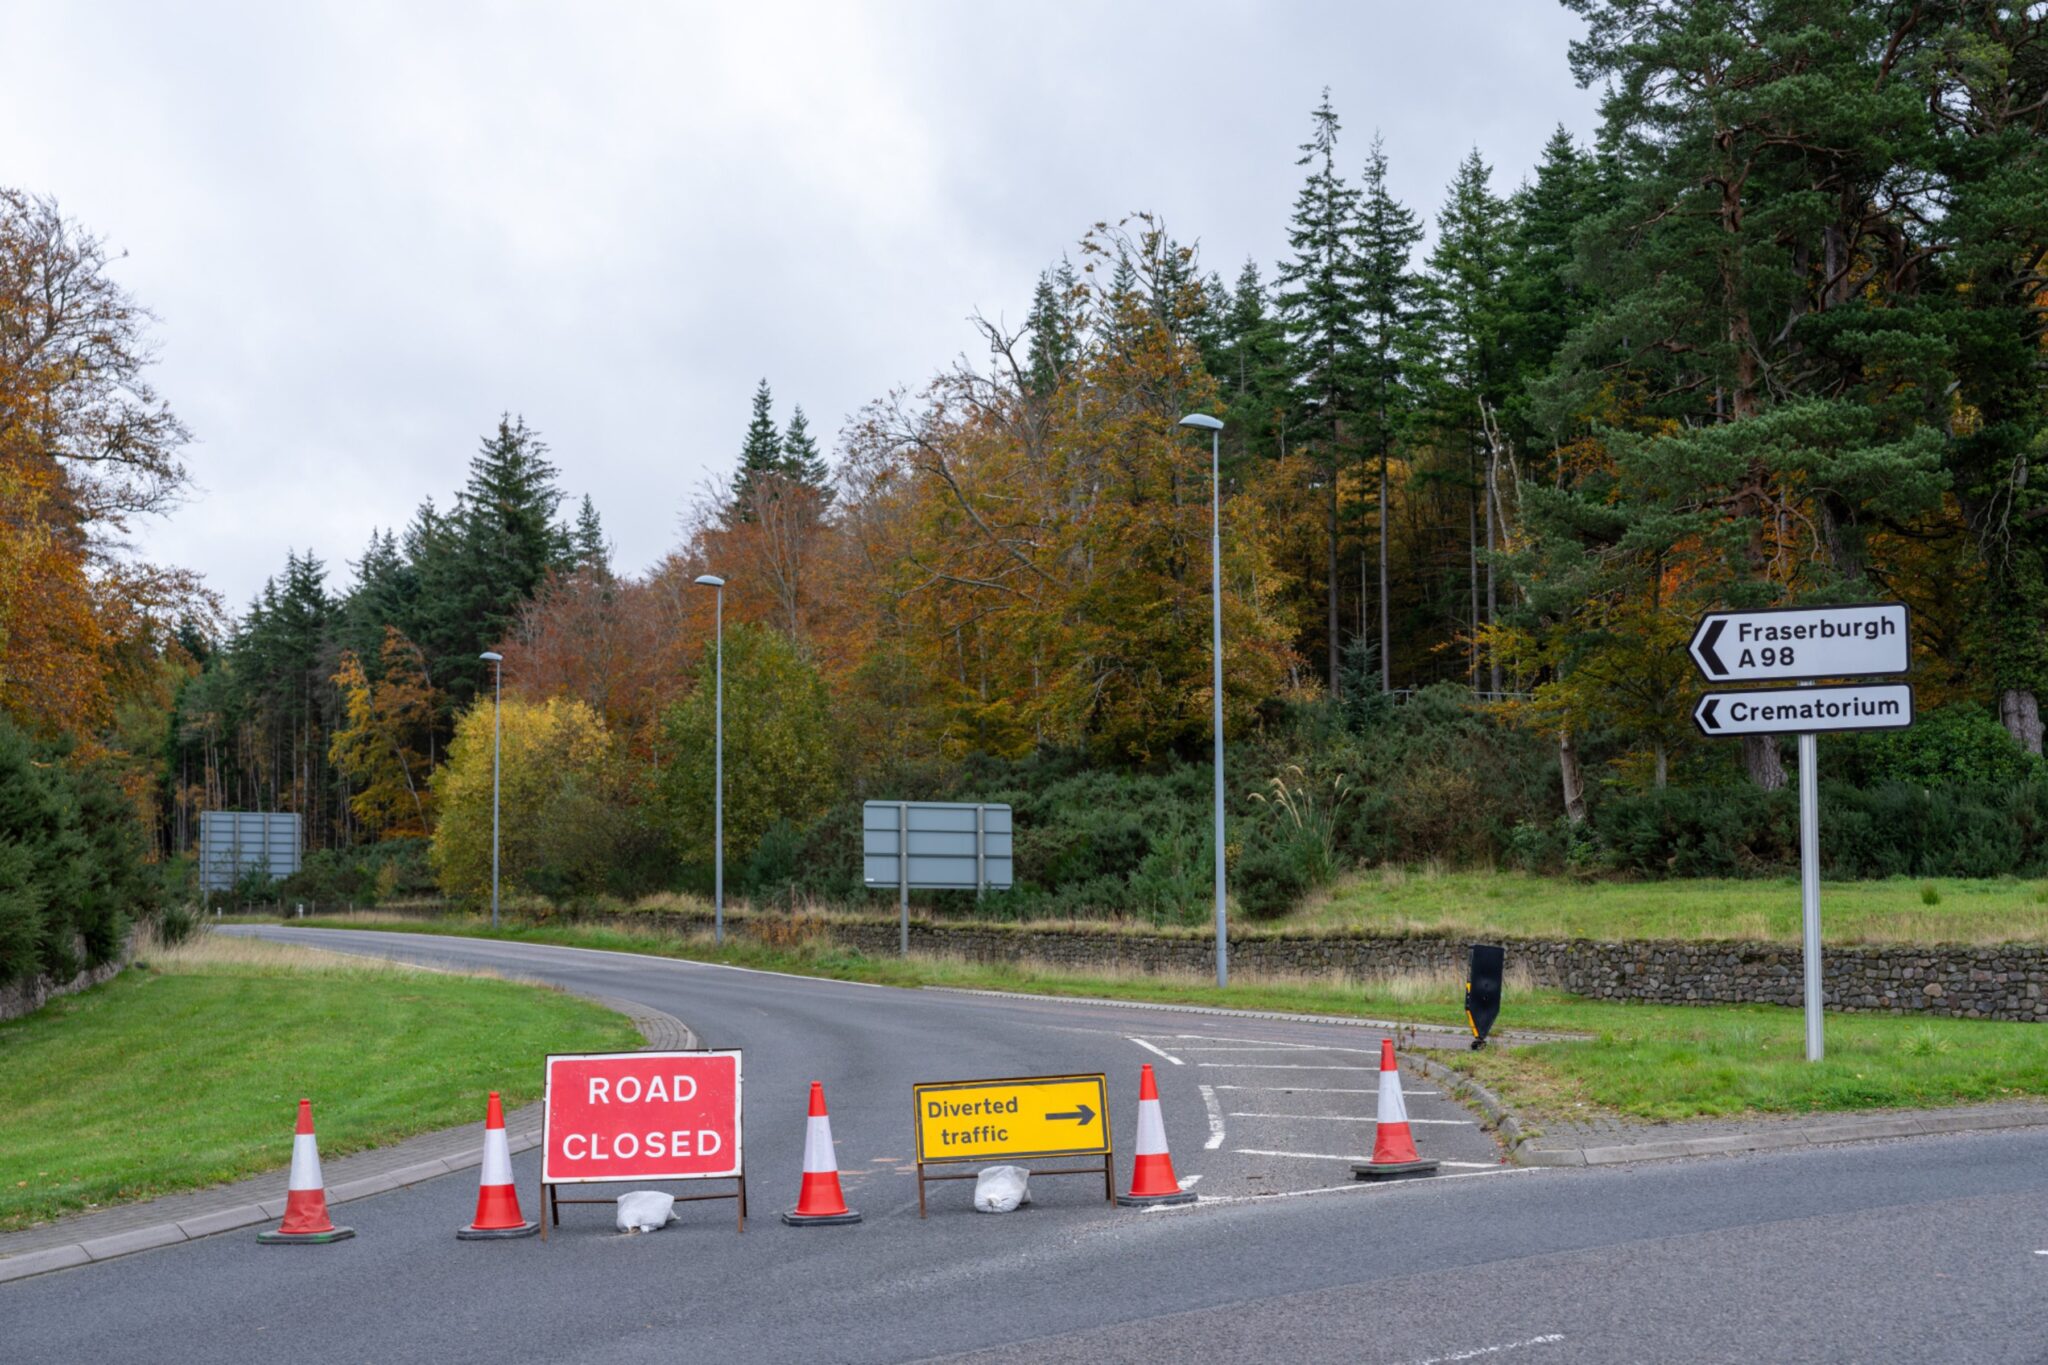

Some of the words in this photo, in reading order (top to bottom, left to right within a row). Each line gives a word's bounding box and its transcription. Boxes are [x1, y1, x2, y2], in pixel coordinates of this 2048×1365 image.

[1739, 616, 1895, 642] Fraserburgh
[1738, 646, 1795, 668] A98
[1730, 697, 1900, 721] Crematorium
[588, 1075, 697, 1104] ROAD
[928, 1096, 1018, 1118] Diverted
[562, 1130, 722, 1160] CLOSED
[941, 1126, 1008, 1145] traffic
